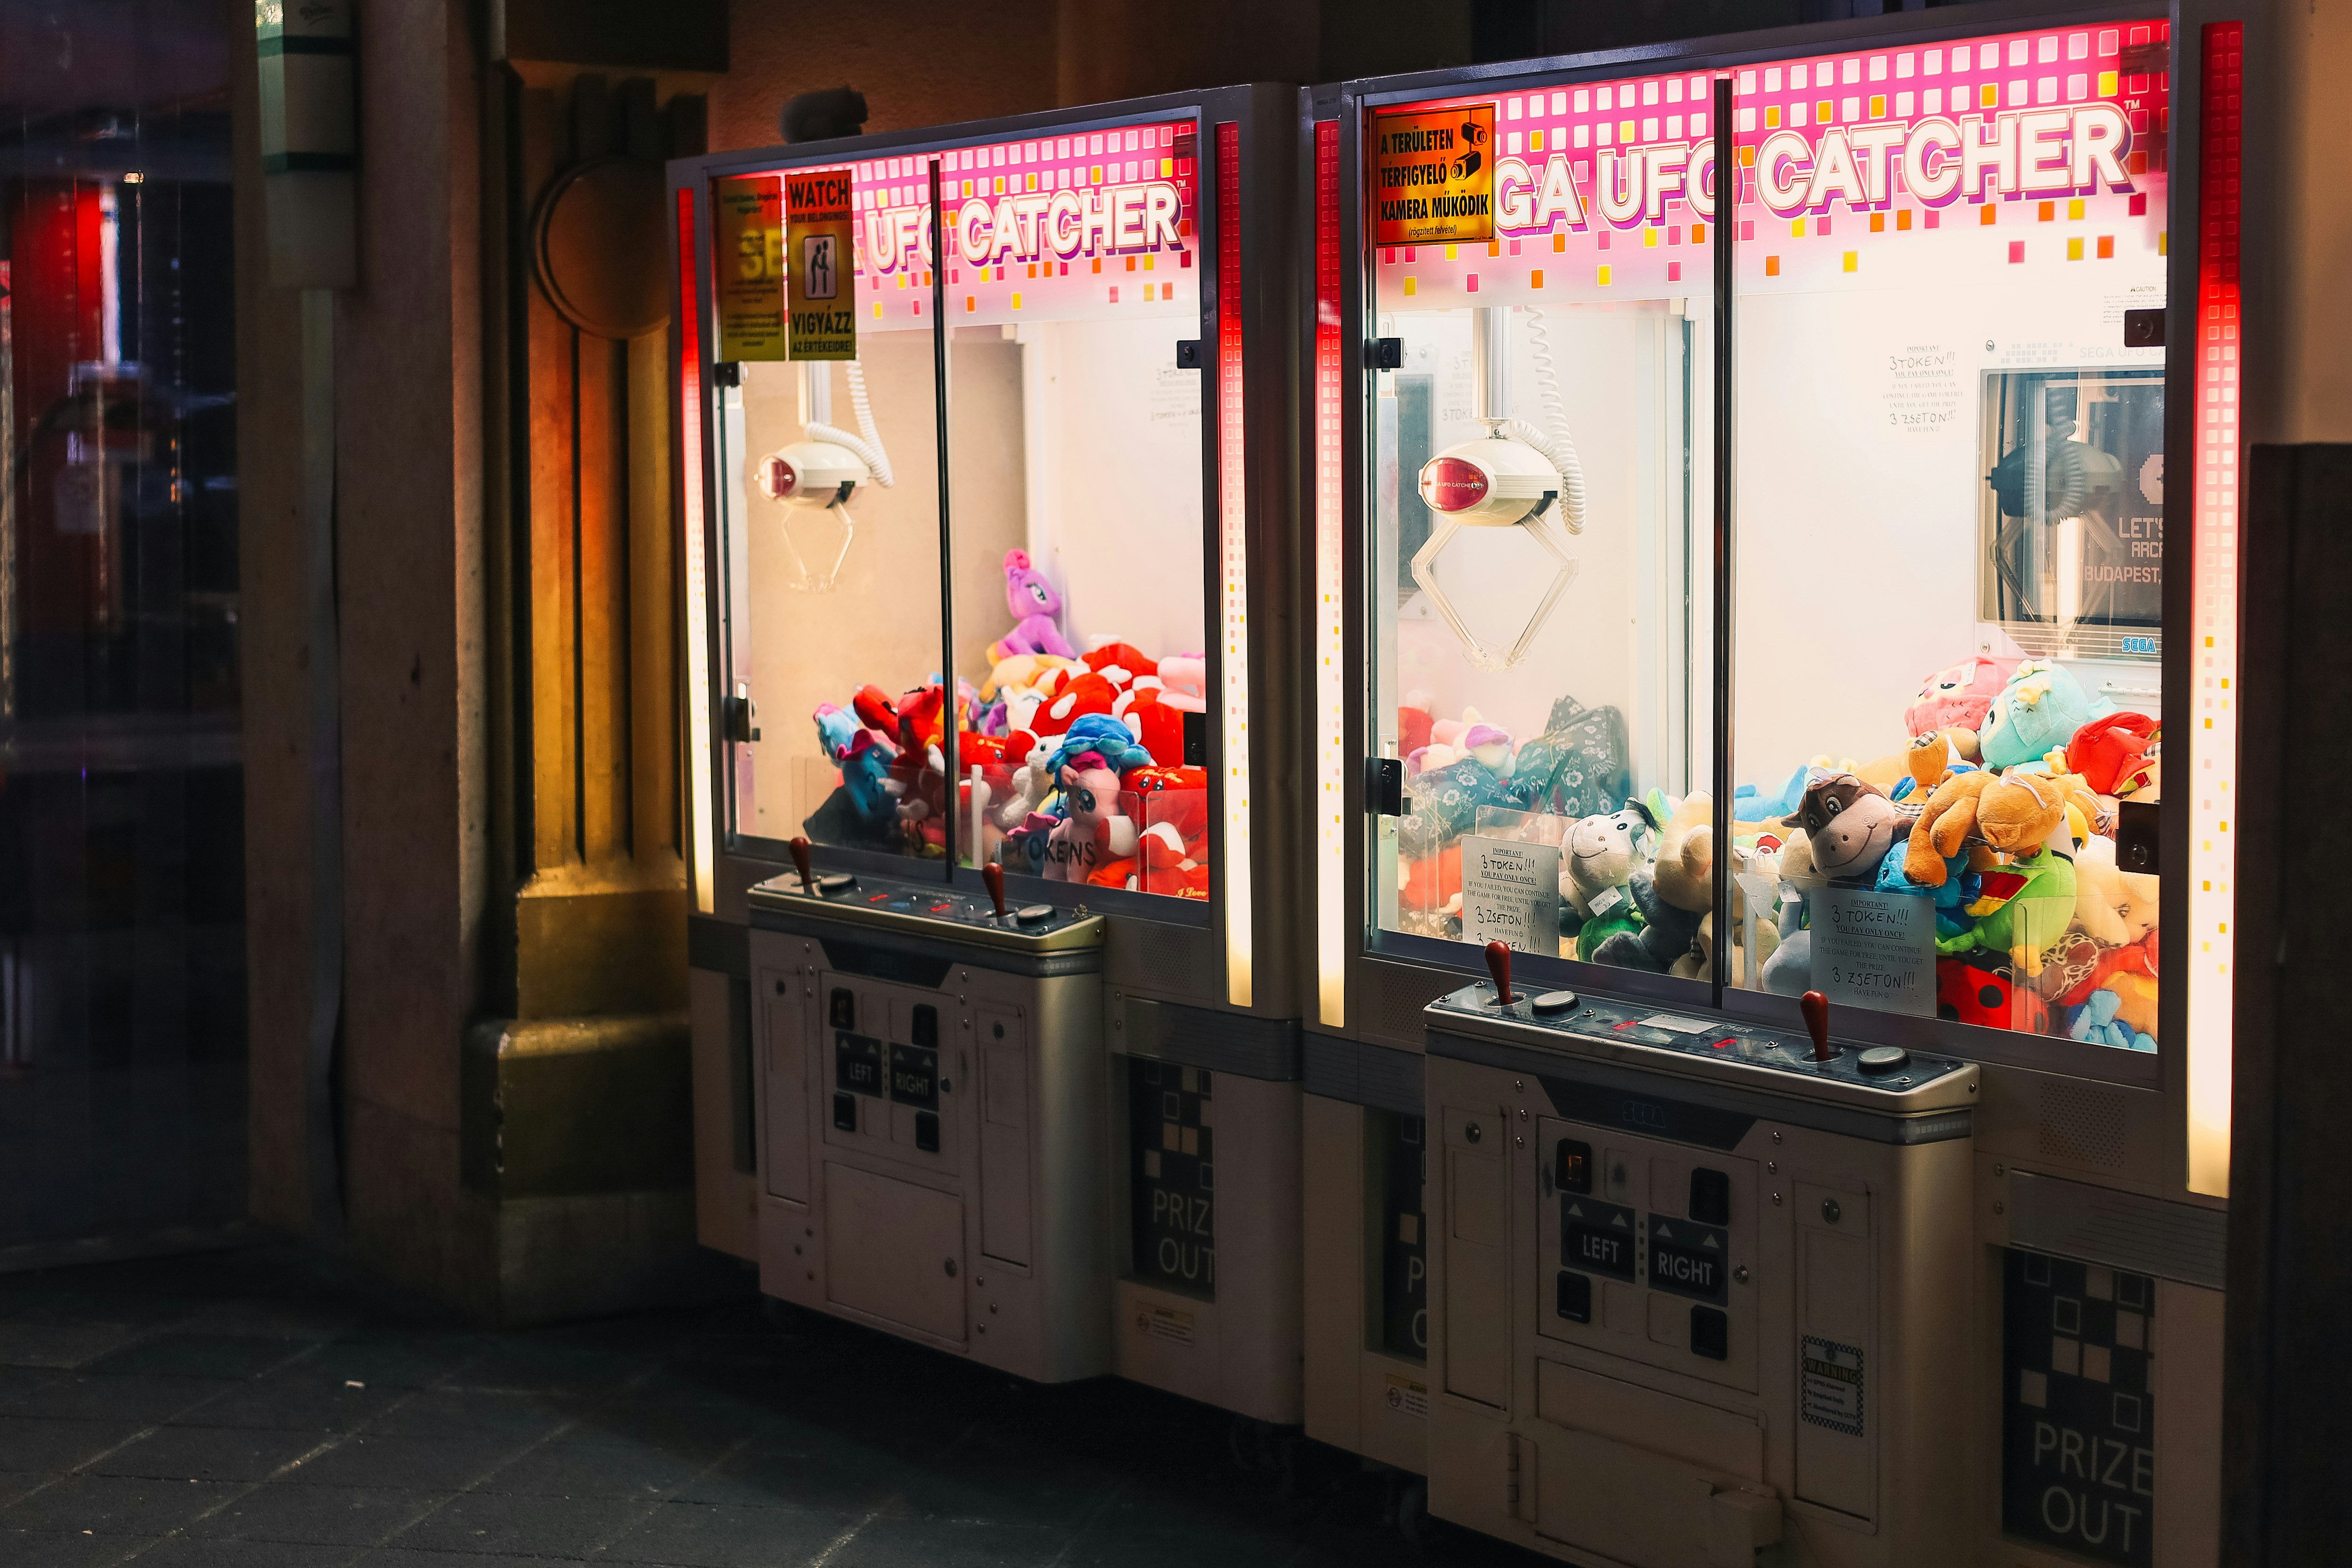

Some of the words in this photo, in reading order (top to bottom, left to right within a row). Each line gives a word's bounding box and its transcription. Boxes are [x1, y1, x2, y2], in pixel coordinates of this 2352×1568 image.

[1381, 134, 1389, 155] A
[1391, 125, 1454, 154] TERÜLETEN
[1755, 101, 2138, 220] CATCHER
[1381, 156, 1447, 188] TÉRFIGYELŐ
[789, 178, 849, 208] WATCH
[1381, 198, 1428, 221] KAMERA
[1432, 189, 1489, 218] MŰKÖDIK
[959, 181, 1185, 268] CATCHER
[1409, 226, 1434, 238] (rögzített
[1435, 225, 1457, 235] felvétel)
[792, 304, 851, 334] VIGYÁZZ
[2079, 347, 2114, 358] SEGA
[2118, 346, 2144, 357] UFO
[2084, 566, 2161, 585] BUDAPEST,
[2121, 636, 2157, 654] SEGA
[1046, 784, 1065, 828] 3
[1015, 835, 1097, 867] TOKENS
[1481, 854, 1488, 869] 3
[1493, 848, 1523, 858] IMPORTANT!
[1485, 883, 1502, 892] FAILED,
[1525, 890, 1550, 898] CONTINUE
[1520, 876, 1537, 884] ONCE!
[1475, 905, 1484, 924] 3
[1832, 904, 1841, 923] 3
[1851, 898, 1889, 909] IMPORTANT!
[1865, 928, 1884, 937] ONLY
[1884, 930, 1905, 938] ONCE!
[1864, 942, 1876, 950] YOU
[1891, 944, 1921, 955] CONTINUE
[1832, 966, 1841, 983] 3
[1854, 988, 1871, 996] HAVE
[1721, 1024, 1754, 1033] CHER
[850, 1061, 872, 1083] LEFT
[895, 1071, 929, 1096] RIGHT
[1154, 1188, 1210, 1236] PRIZ
[1159, 1236, 1215, 1283] OUT
[1583, 1233, 1619, 1264] LEFT
[1657, 1251, 1713, 1286] RIGHT
[1807, 1358, 1856, 1383] WARNING
[2034, 1420, 2154, 1496] PRIZE
[2043, 1485, 2142, 1553] OUT
